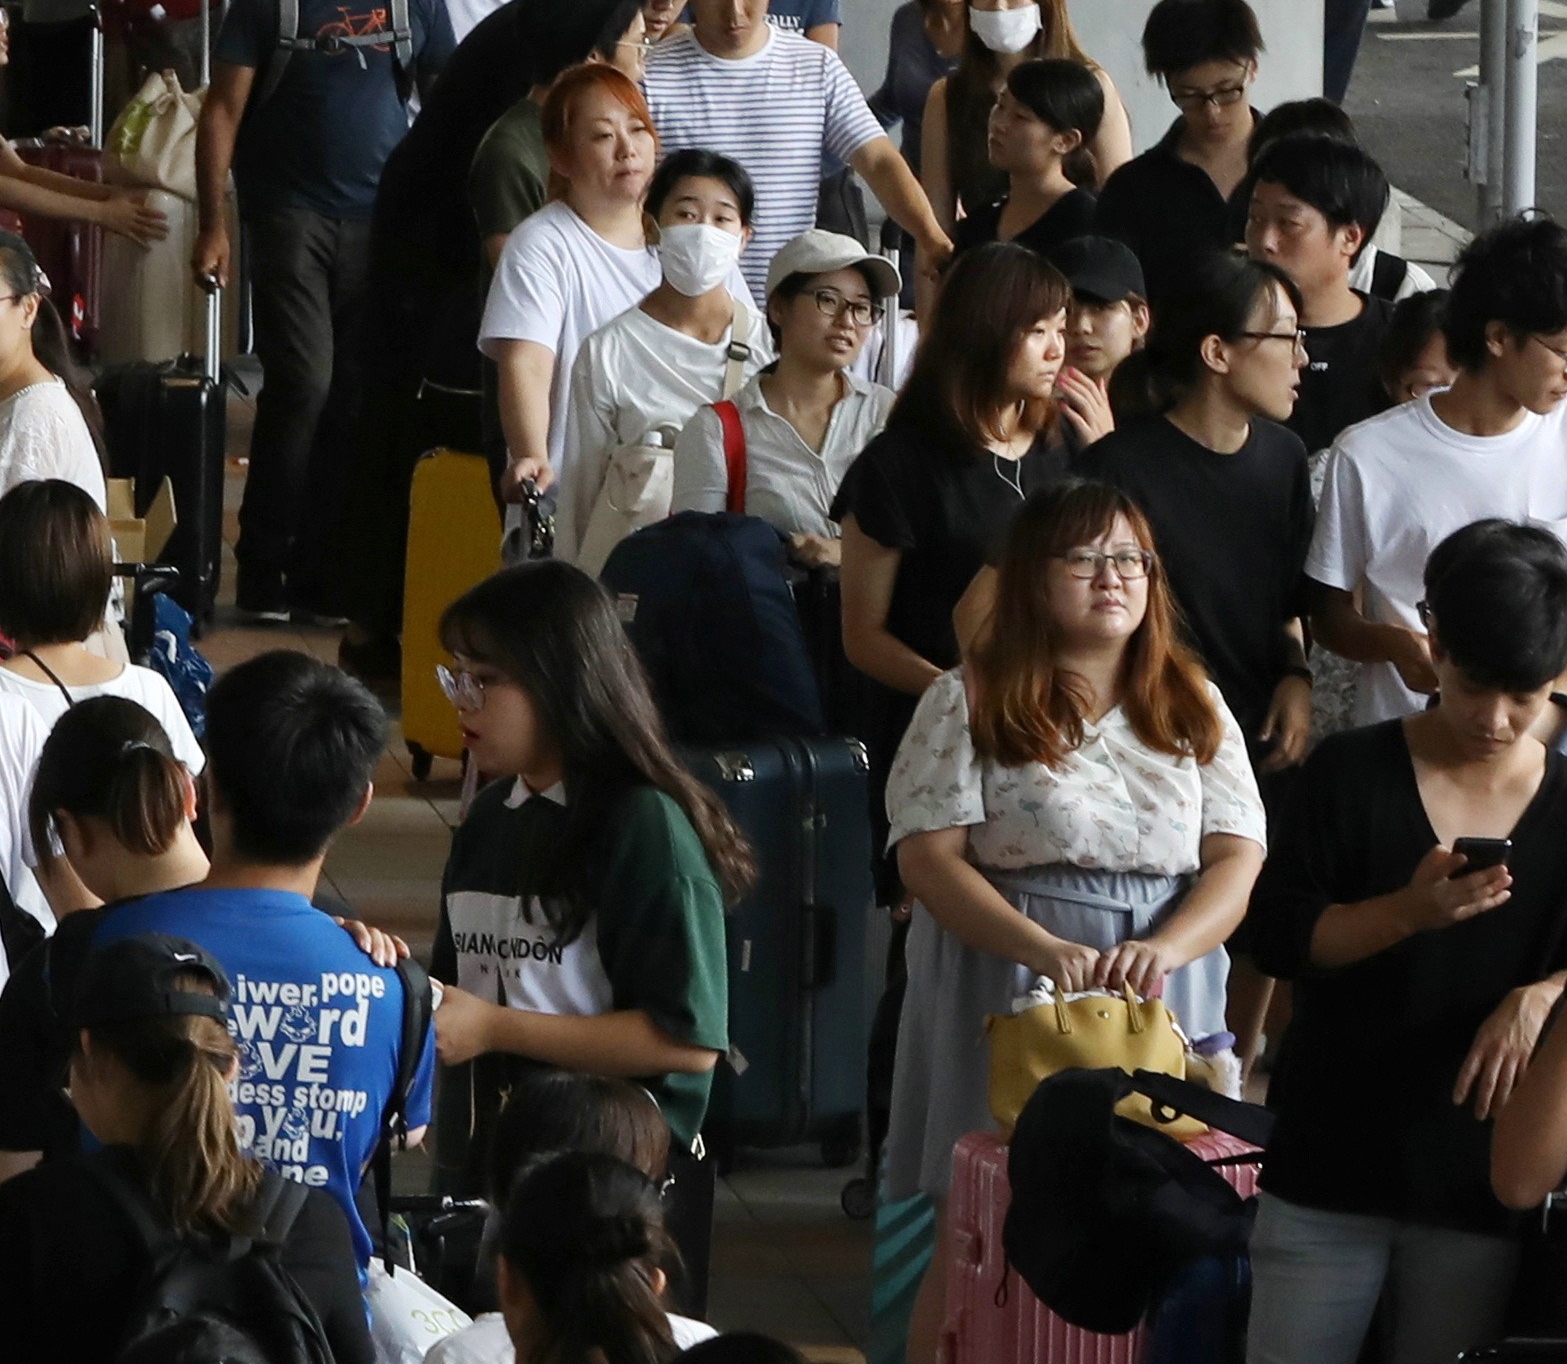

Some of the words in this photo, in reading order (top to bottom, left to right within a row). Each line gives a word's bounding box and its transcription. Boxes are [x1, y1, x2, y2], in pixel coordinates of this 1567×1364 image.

[321, 972, 386, 1002] pope
[293, 1081, 368, 1119] stomp
[253, 1132, 310, 1164] and
